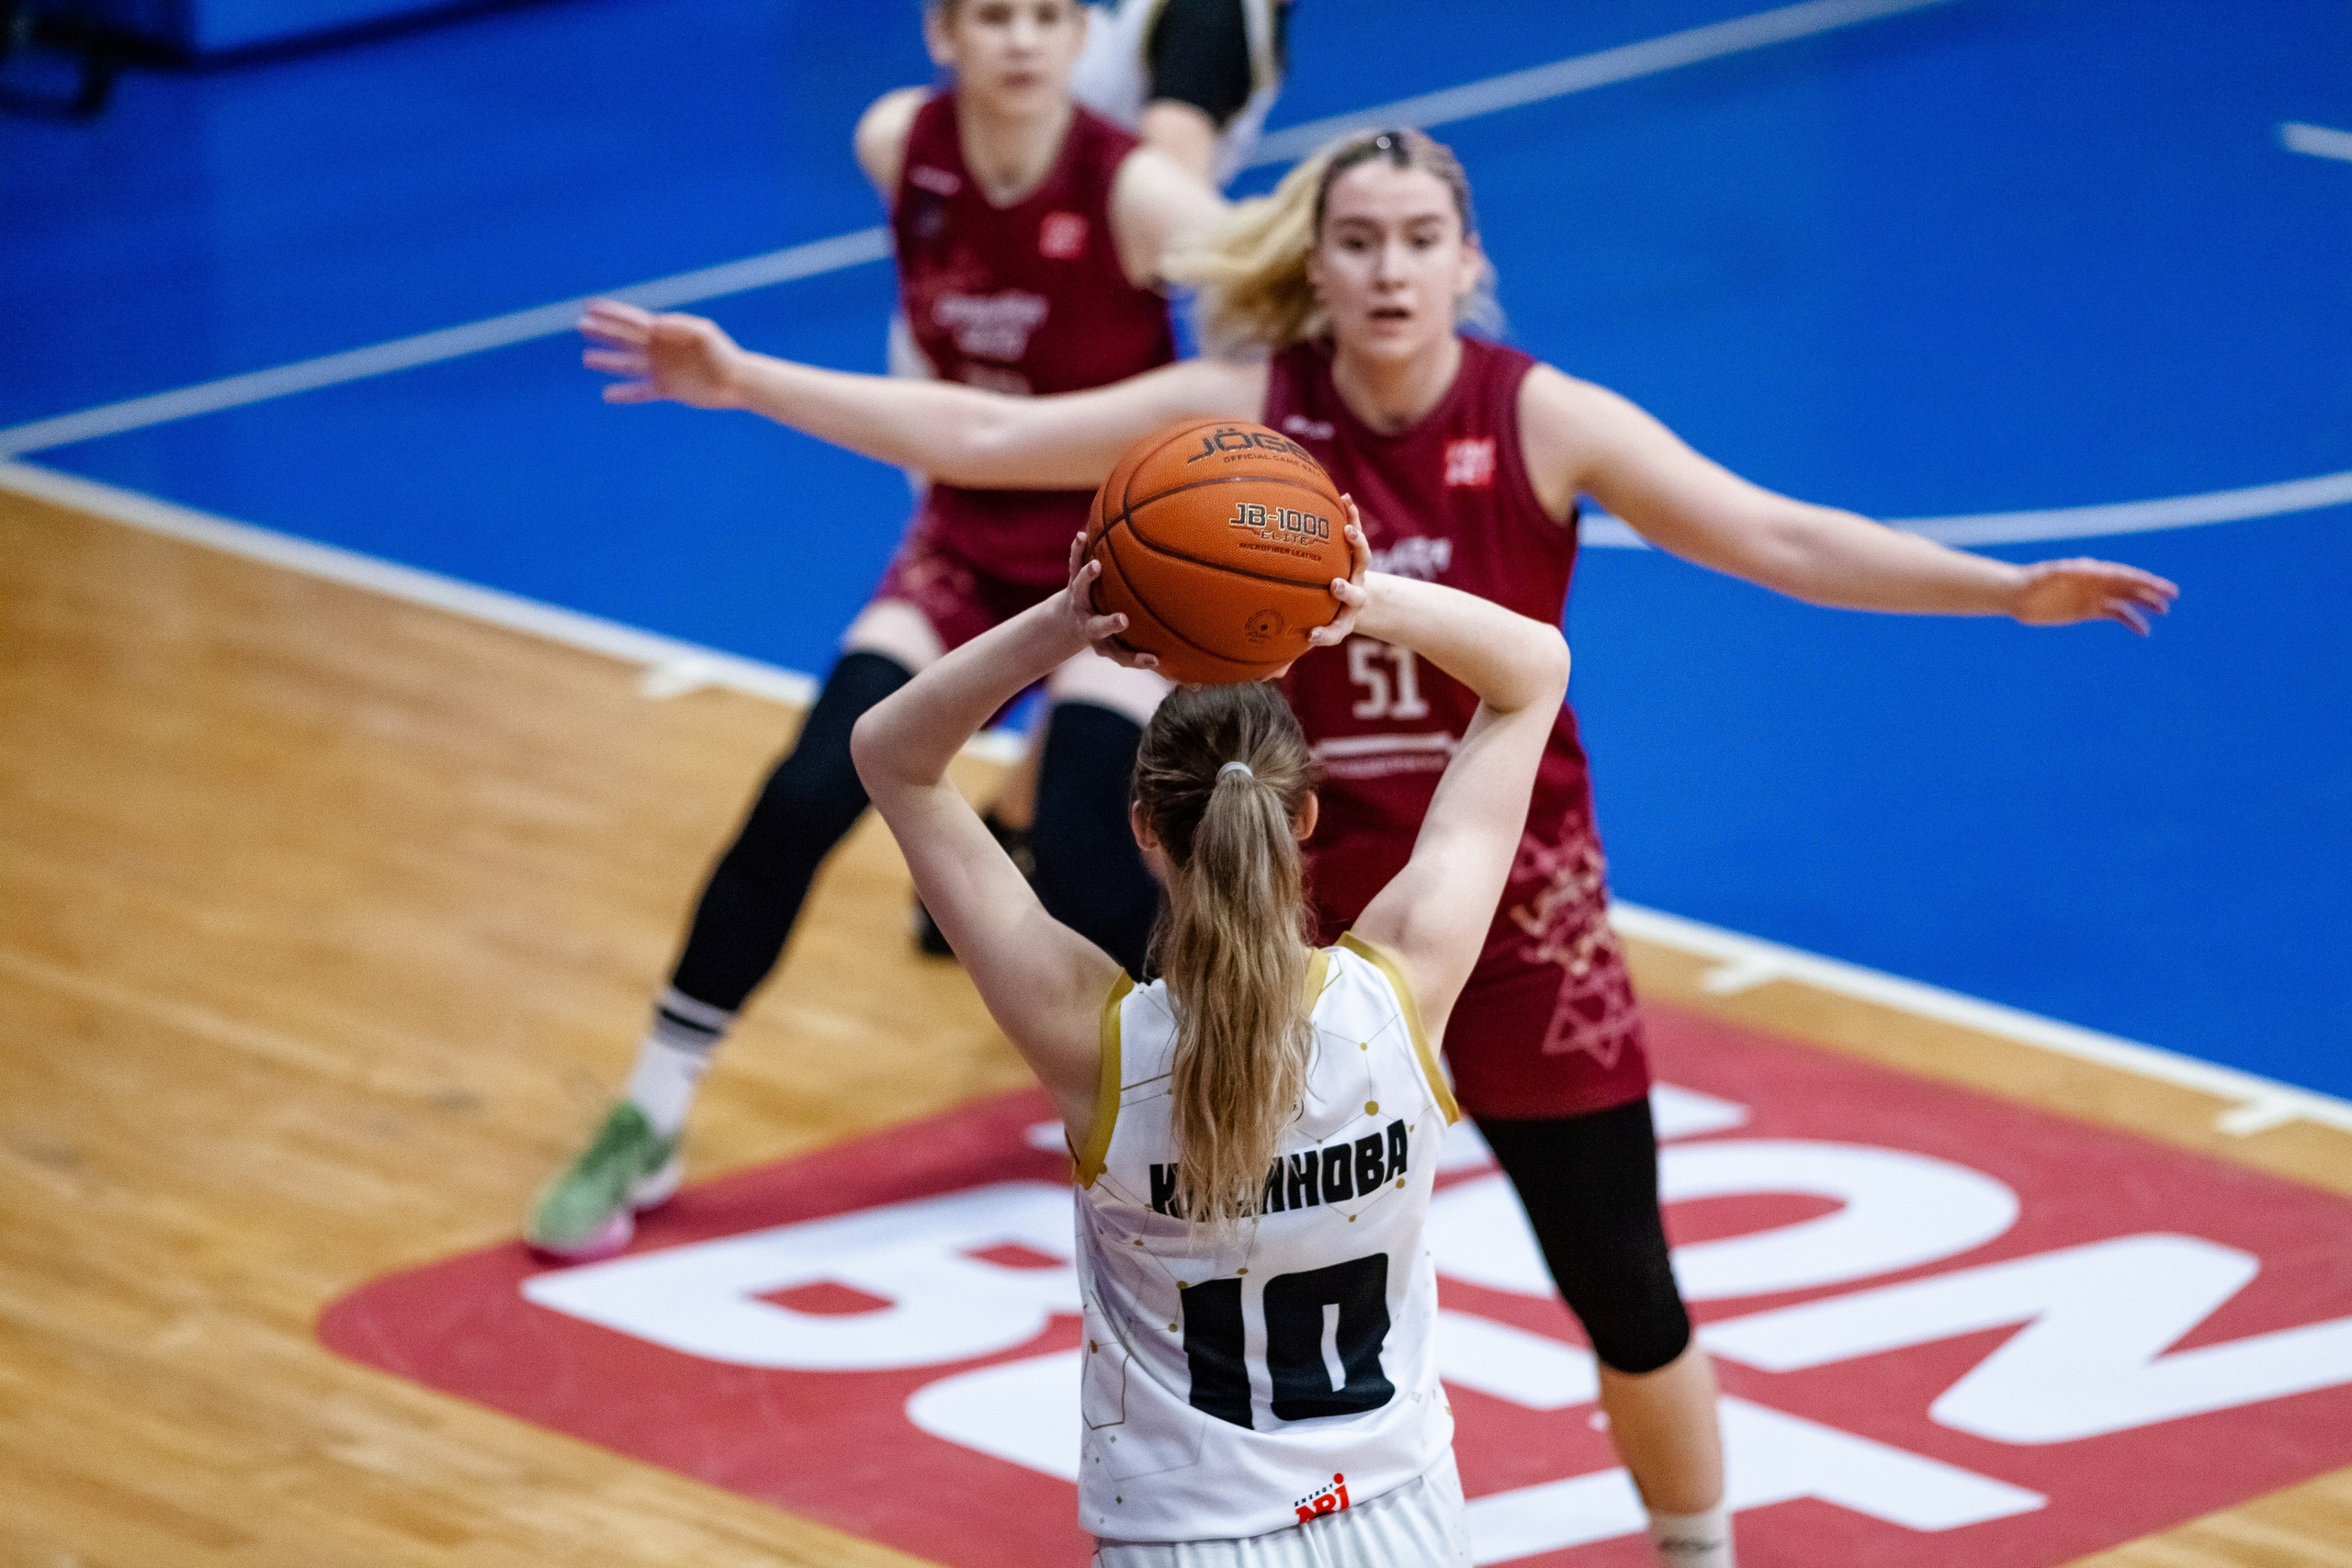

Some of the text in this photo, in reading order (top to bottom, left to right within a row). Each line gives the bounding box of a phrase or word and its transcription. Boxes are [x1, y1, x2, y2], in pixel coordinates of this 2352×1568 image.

[1223, 453, 1272, 464] OFFICIAL
[1229, 502, 1329, 540] JB-1000
[1238, 542, 1322, 563] MICROFIBER LEATHER
[1261, 529, 1308, 546] ELITE
[1348, 641, 1430, 721] 51
[1149, 1119, 1408, 1223] КИНОВА
[1181, 1252, 1396, 1431] 10
[1295, 1483, 1333, 1507] ENERGY
